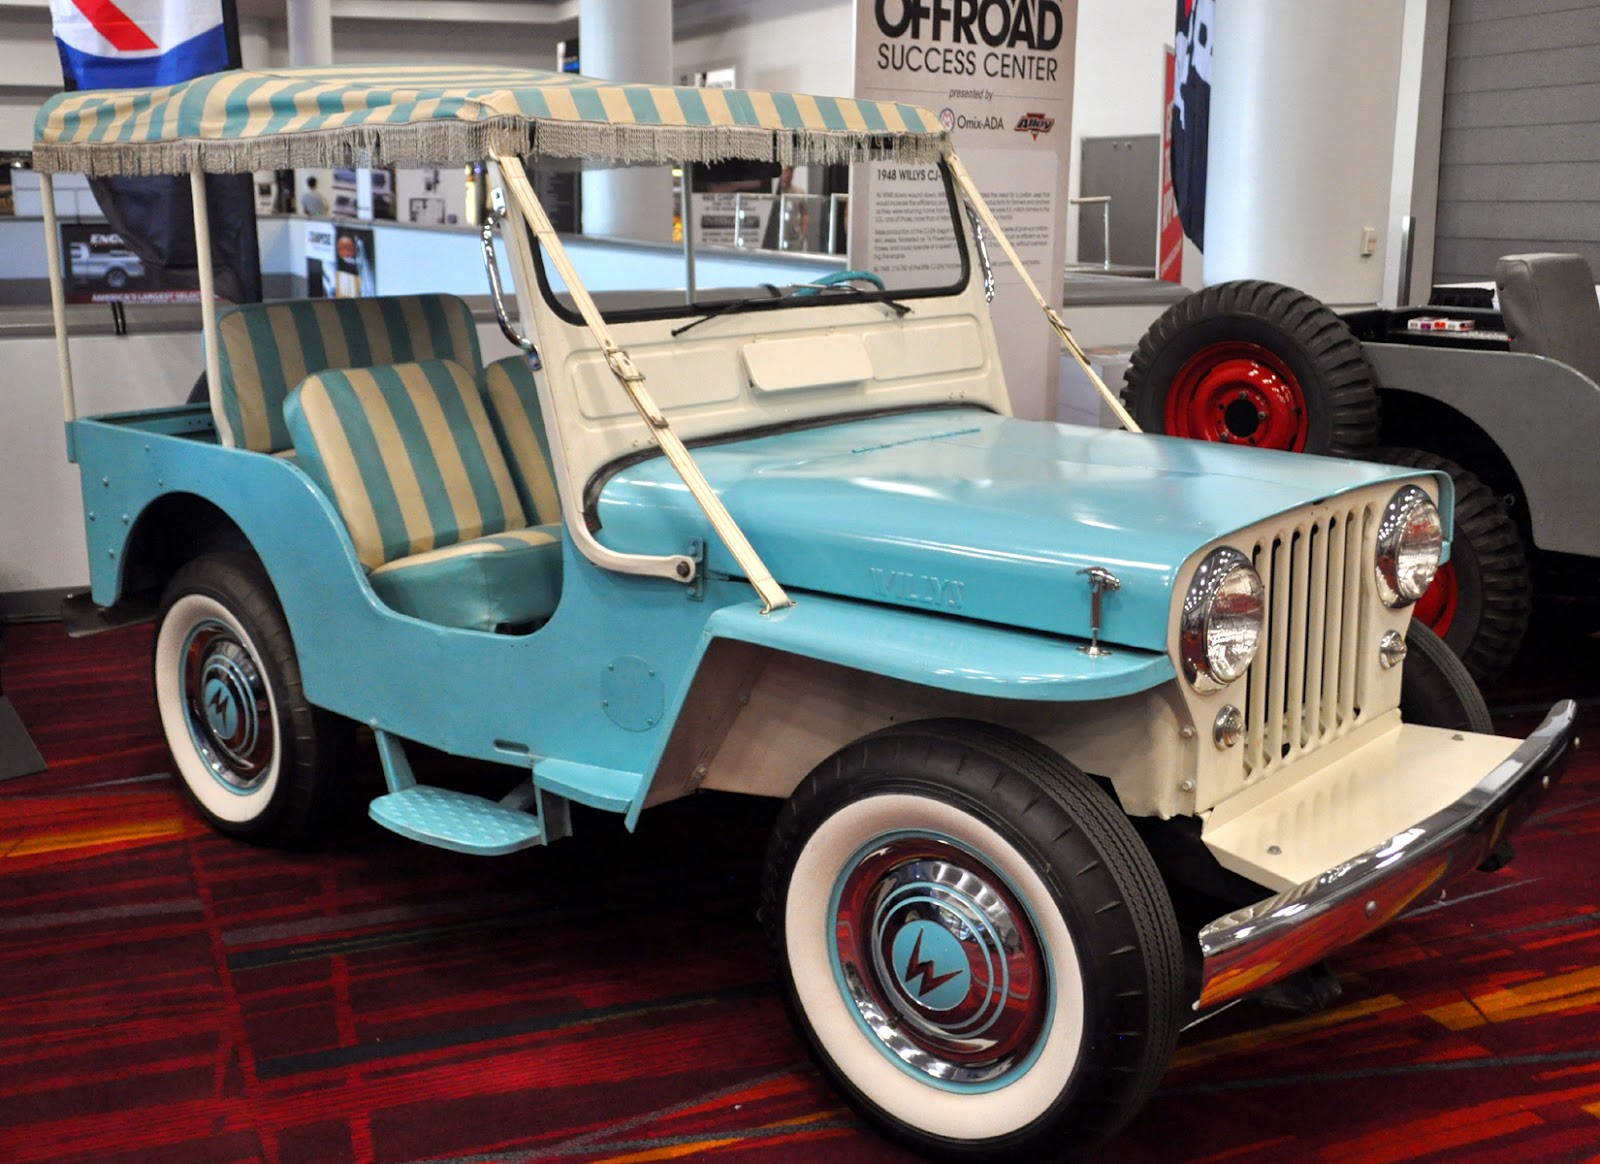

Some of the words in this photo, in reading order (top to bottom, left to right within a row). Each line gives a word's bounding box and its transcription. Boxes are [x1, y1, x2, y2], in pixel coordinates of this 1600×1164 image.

[874, 0, 1063, 51] OFFROAD
[877, 43, 976, 76] SUCCESS
[983, 52, 1058, 82] CENTER
[949, 88, 984, 99] presented
[985, 90, 994, 102] by
[957, 115, 1005, 130] Omix-ADA
[1017, 117, 1052, 130] Alloy
[877, 169, 897, 180] 1948
[898, 169, 926, 181] WILLYS
[927, 169, 942, 180] CJ-
